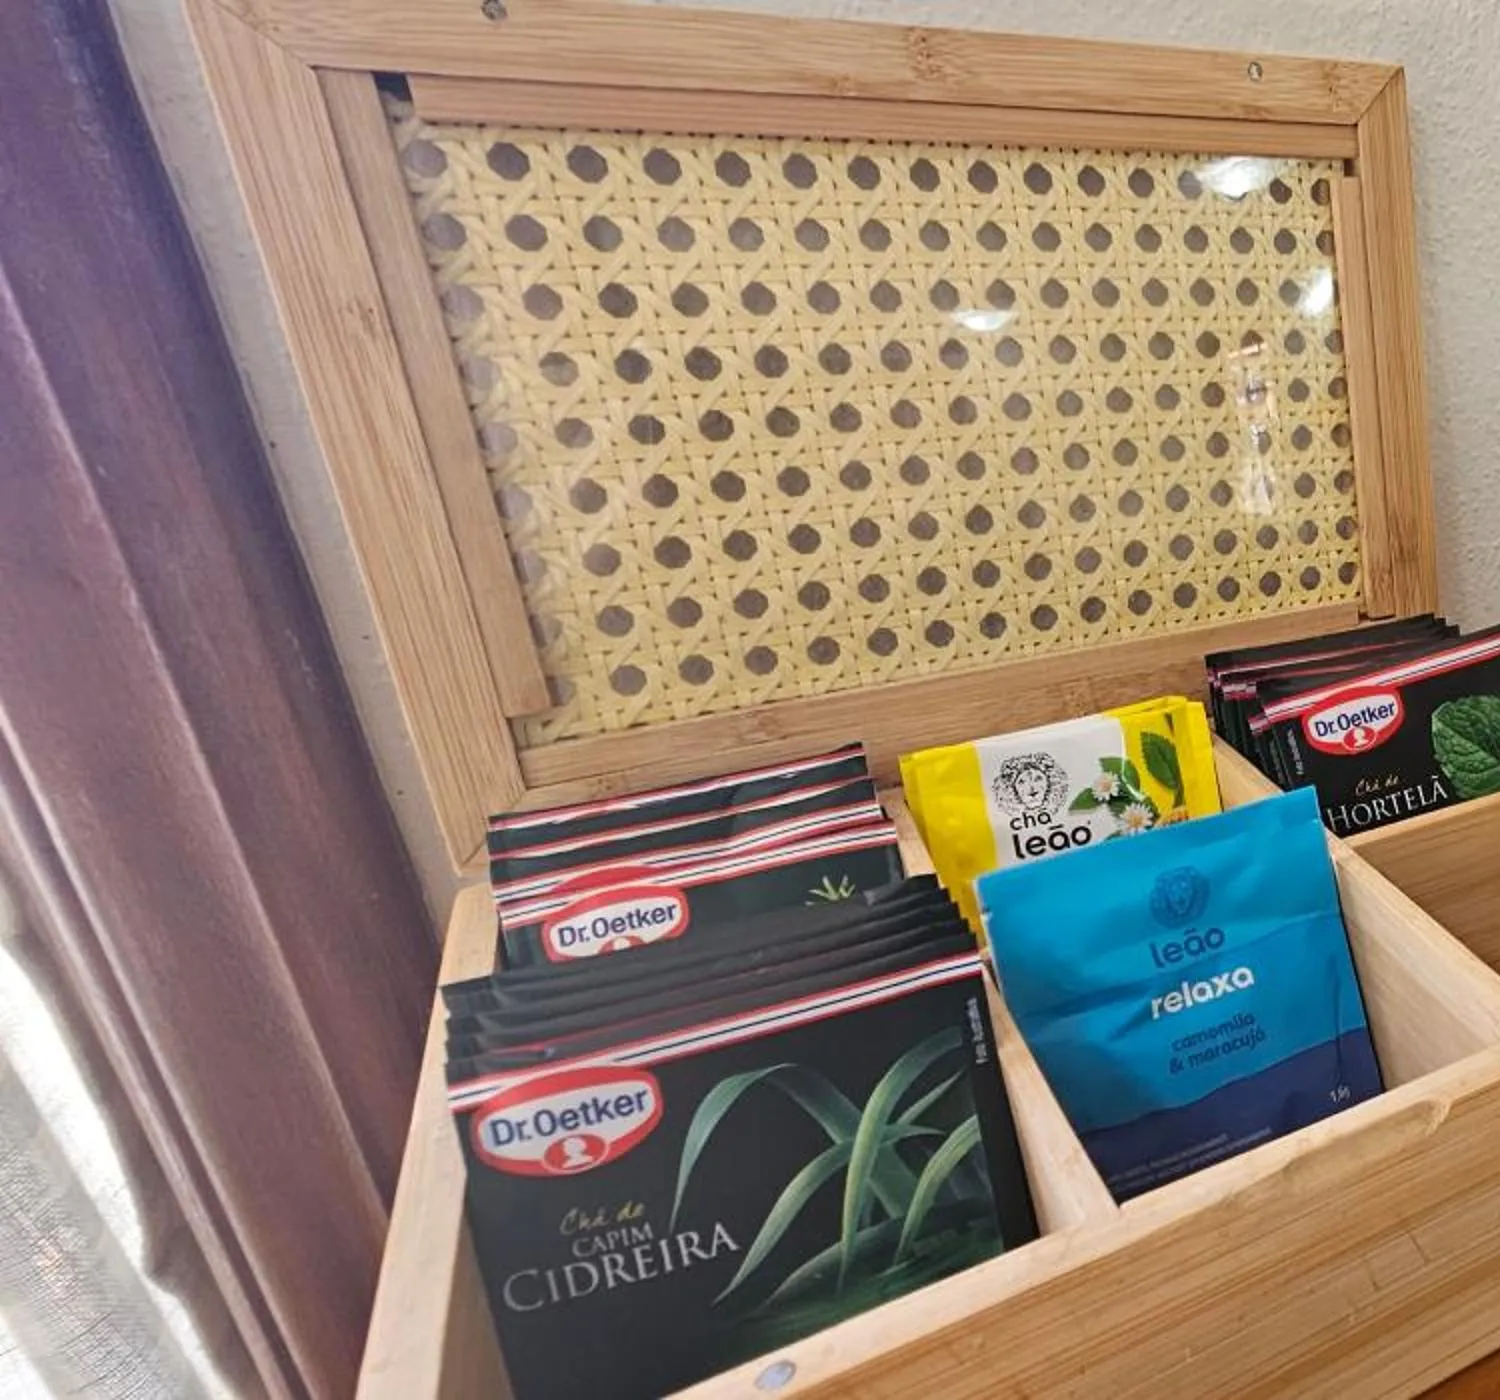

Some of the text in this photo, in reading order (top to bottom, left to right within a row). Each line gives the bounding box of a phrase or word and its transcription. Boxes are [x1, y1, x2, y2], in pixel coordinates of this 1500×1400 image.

[1326, 775, 1450, 833] HORTELÃ
[1012, 824, 1092, 860] leão
[1150, 928, 1225, 968] leão
[1151, 967, 1255, 1020] relaxa
[1171, 1013, 1256, 1051] camomila
[1188, 1025, 1266, 1069] maracujá
[572, 1221, 654, 1257] CAPIM
[503, 1221, 741, 1312] CIDREIRA
